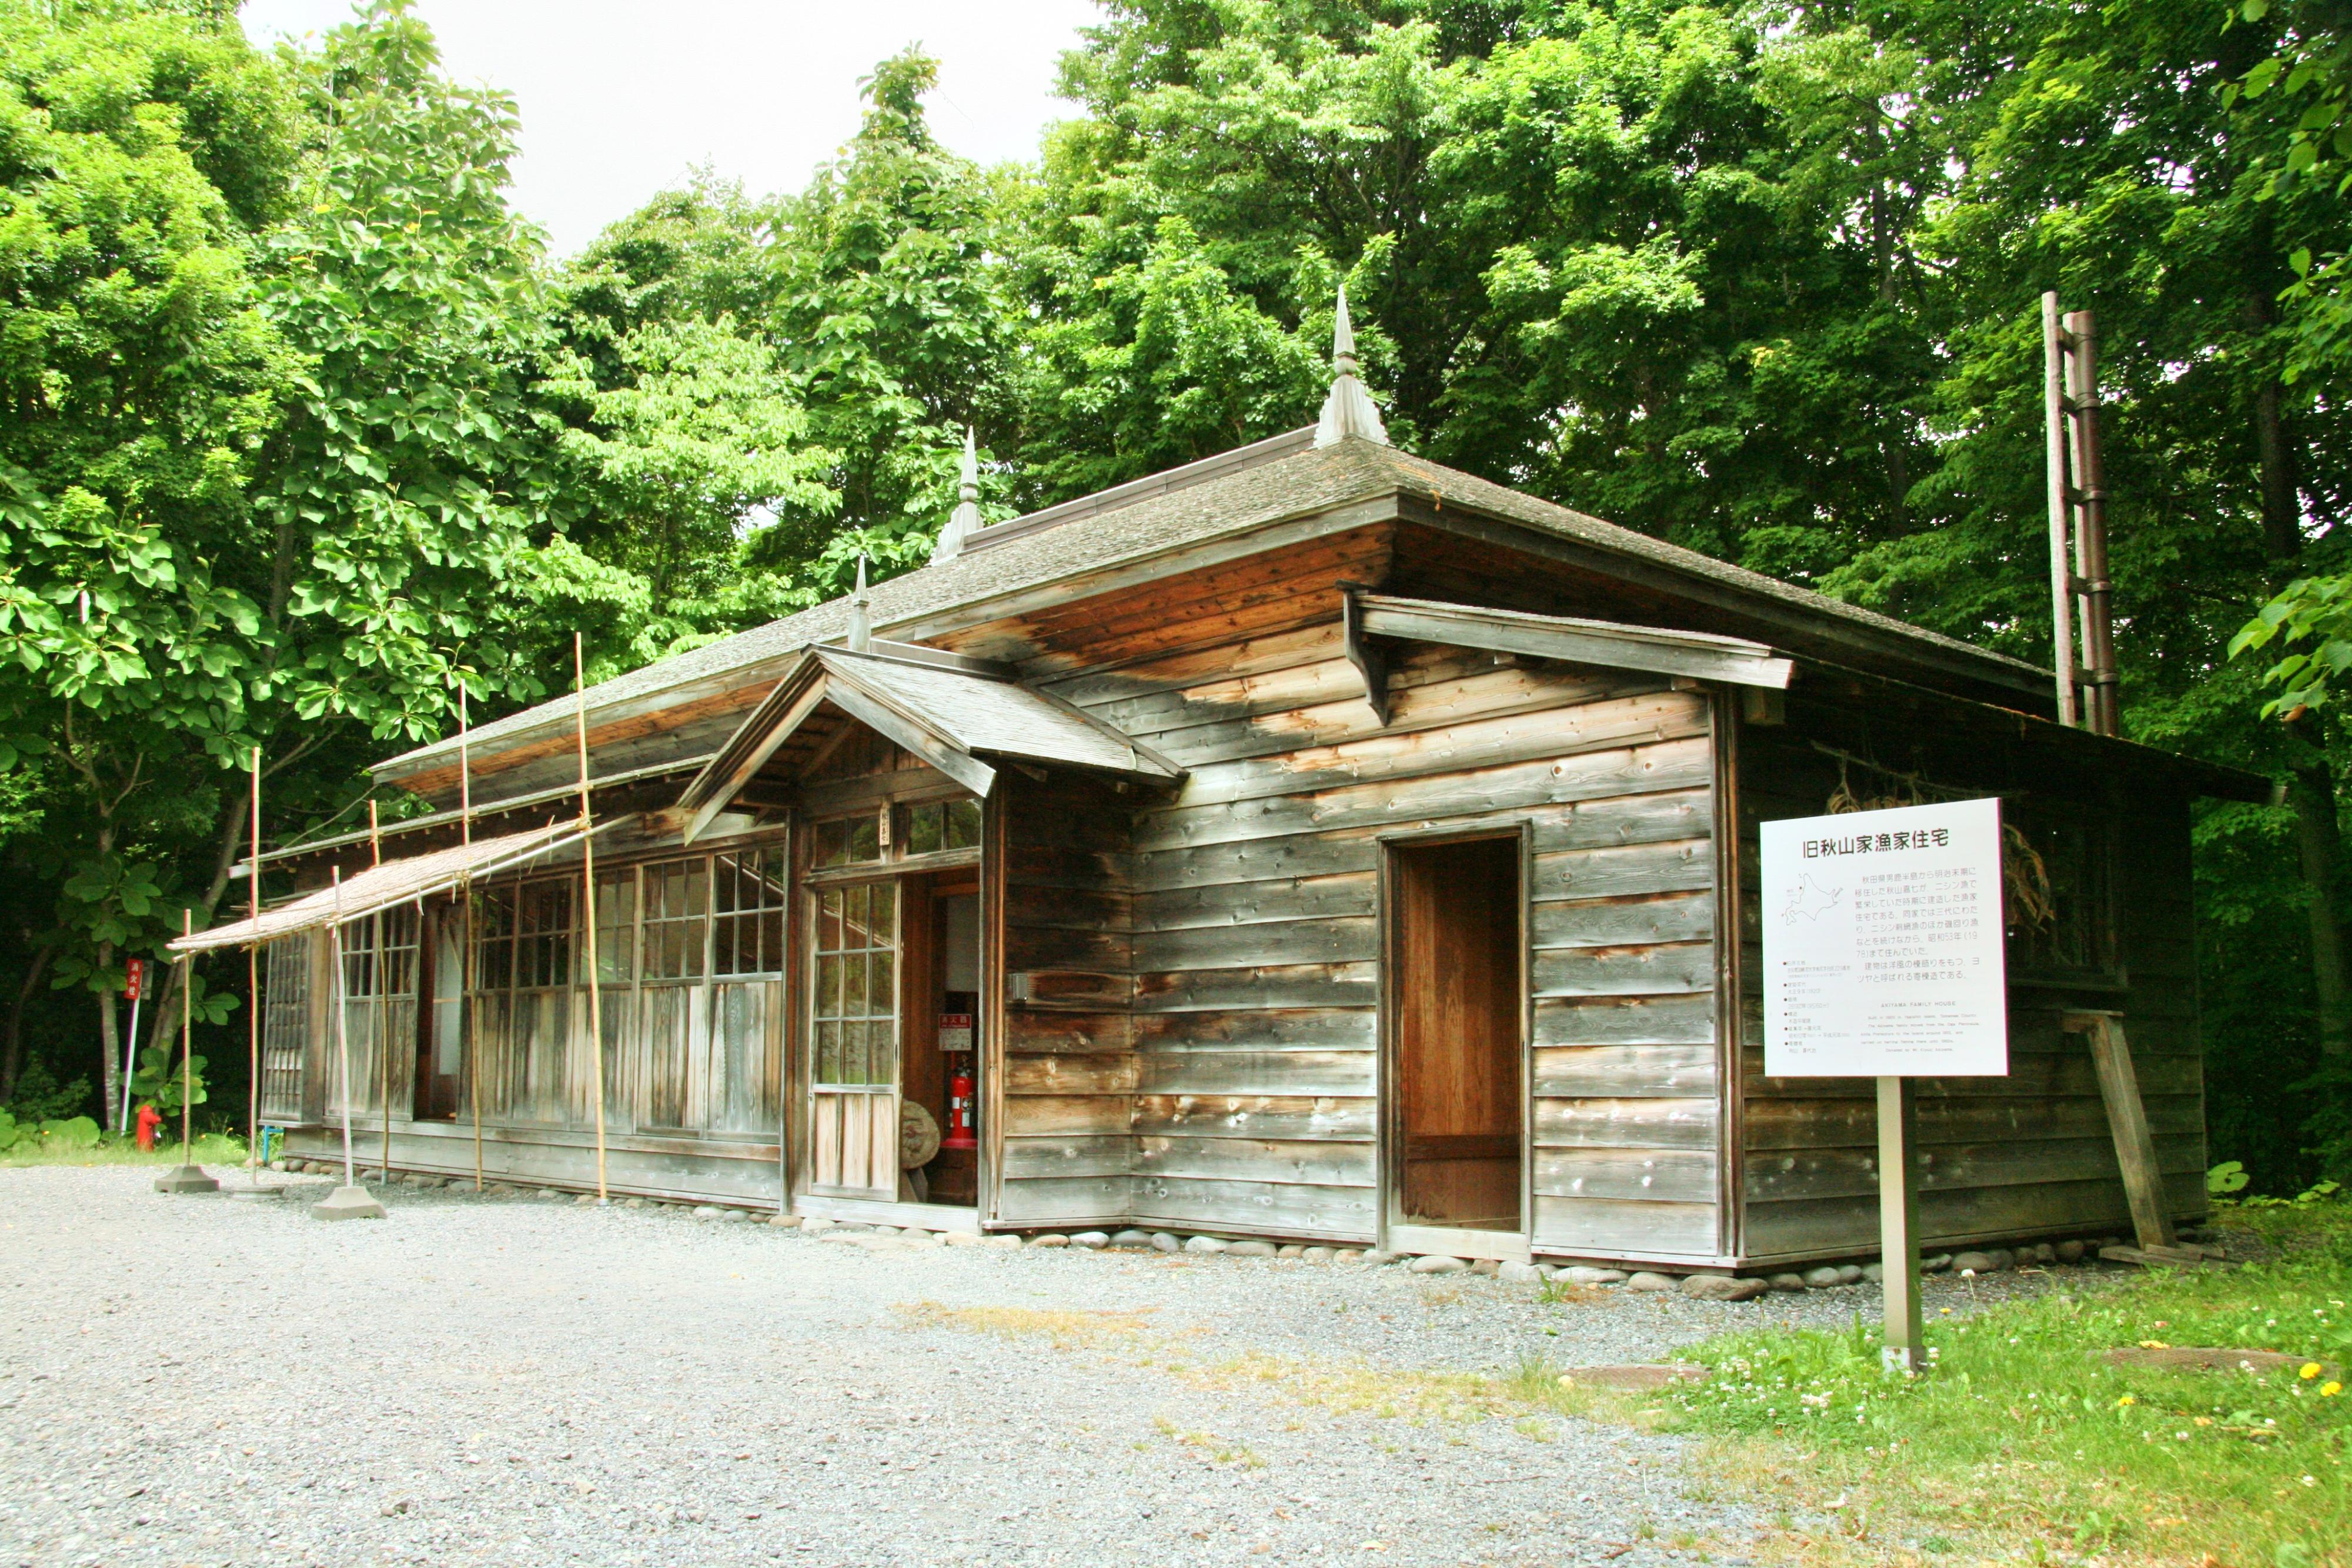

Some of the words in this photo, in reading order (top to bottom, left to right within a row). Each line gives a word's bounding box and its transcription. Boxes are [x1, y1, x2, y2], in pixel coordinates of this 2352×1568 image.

[1803, 828, 1949, 858] 旧秋山家漁家住宅
[1862, 867, 1976, 884] 秋田県男鹿半島から明治末期に
